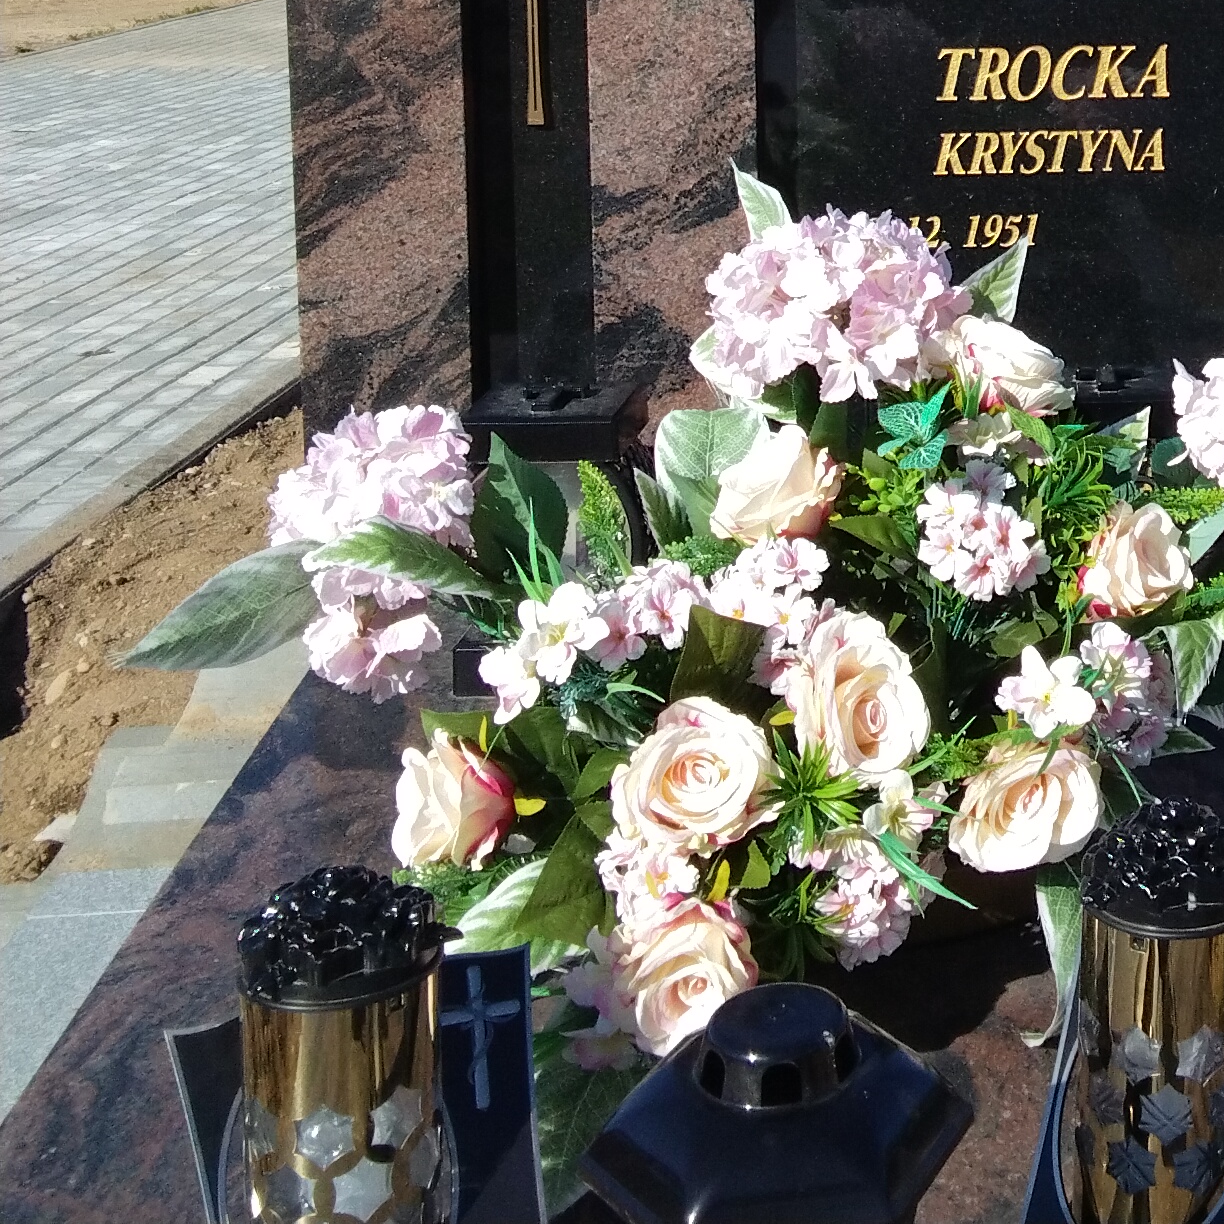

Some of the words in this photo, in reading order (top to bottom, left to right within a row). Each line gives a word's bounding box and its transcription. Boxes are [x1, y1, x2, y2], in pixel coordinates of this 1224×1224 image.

[936, 43, 1171, 101] TROCKA
[934, 129, 1165, 176] KRYSTYNA
[962, 213, 1039, 248] 1951
